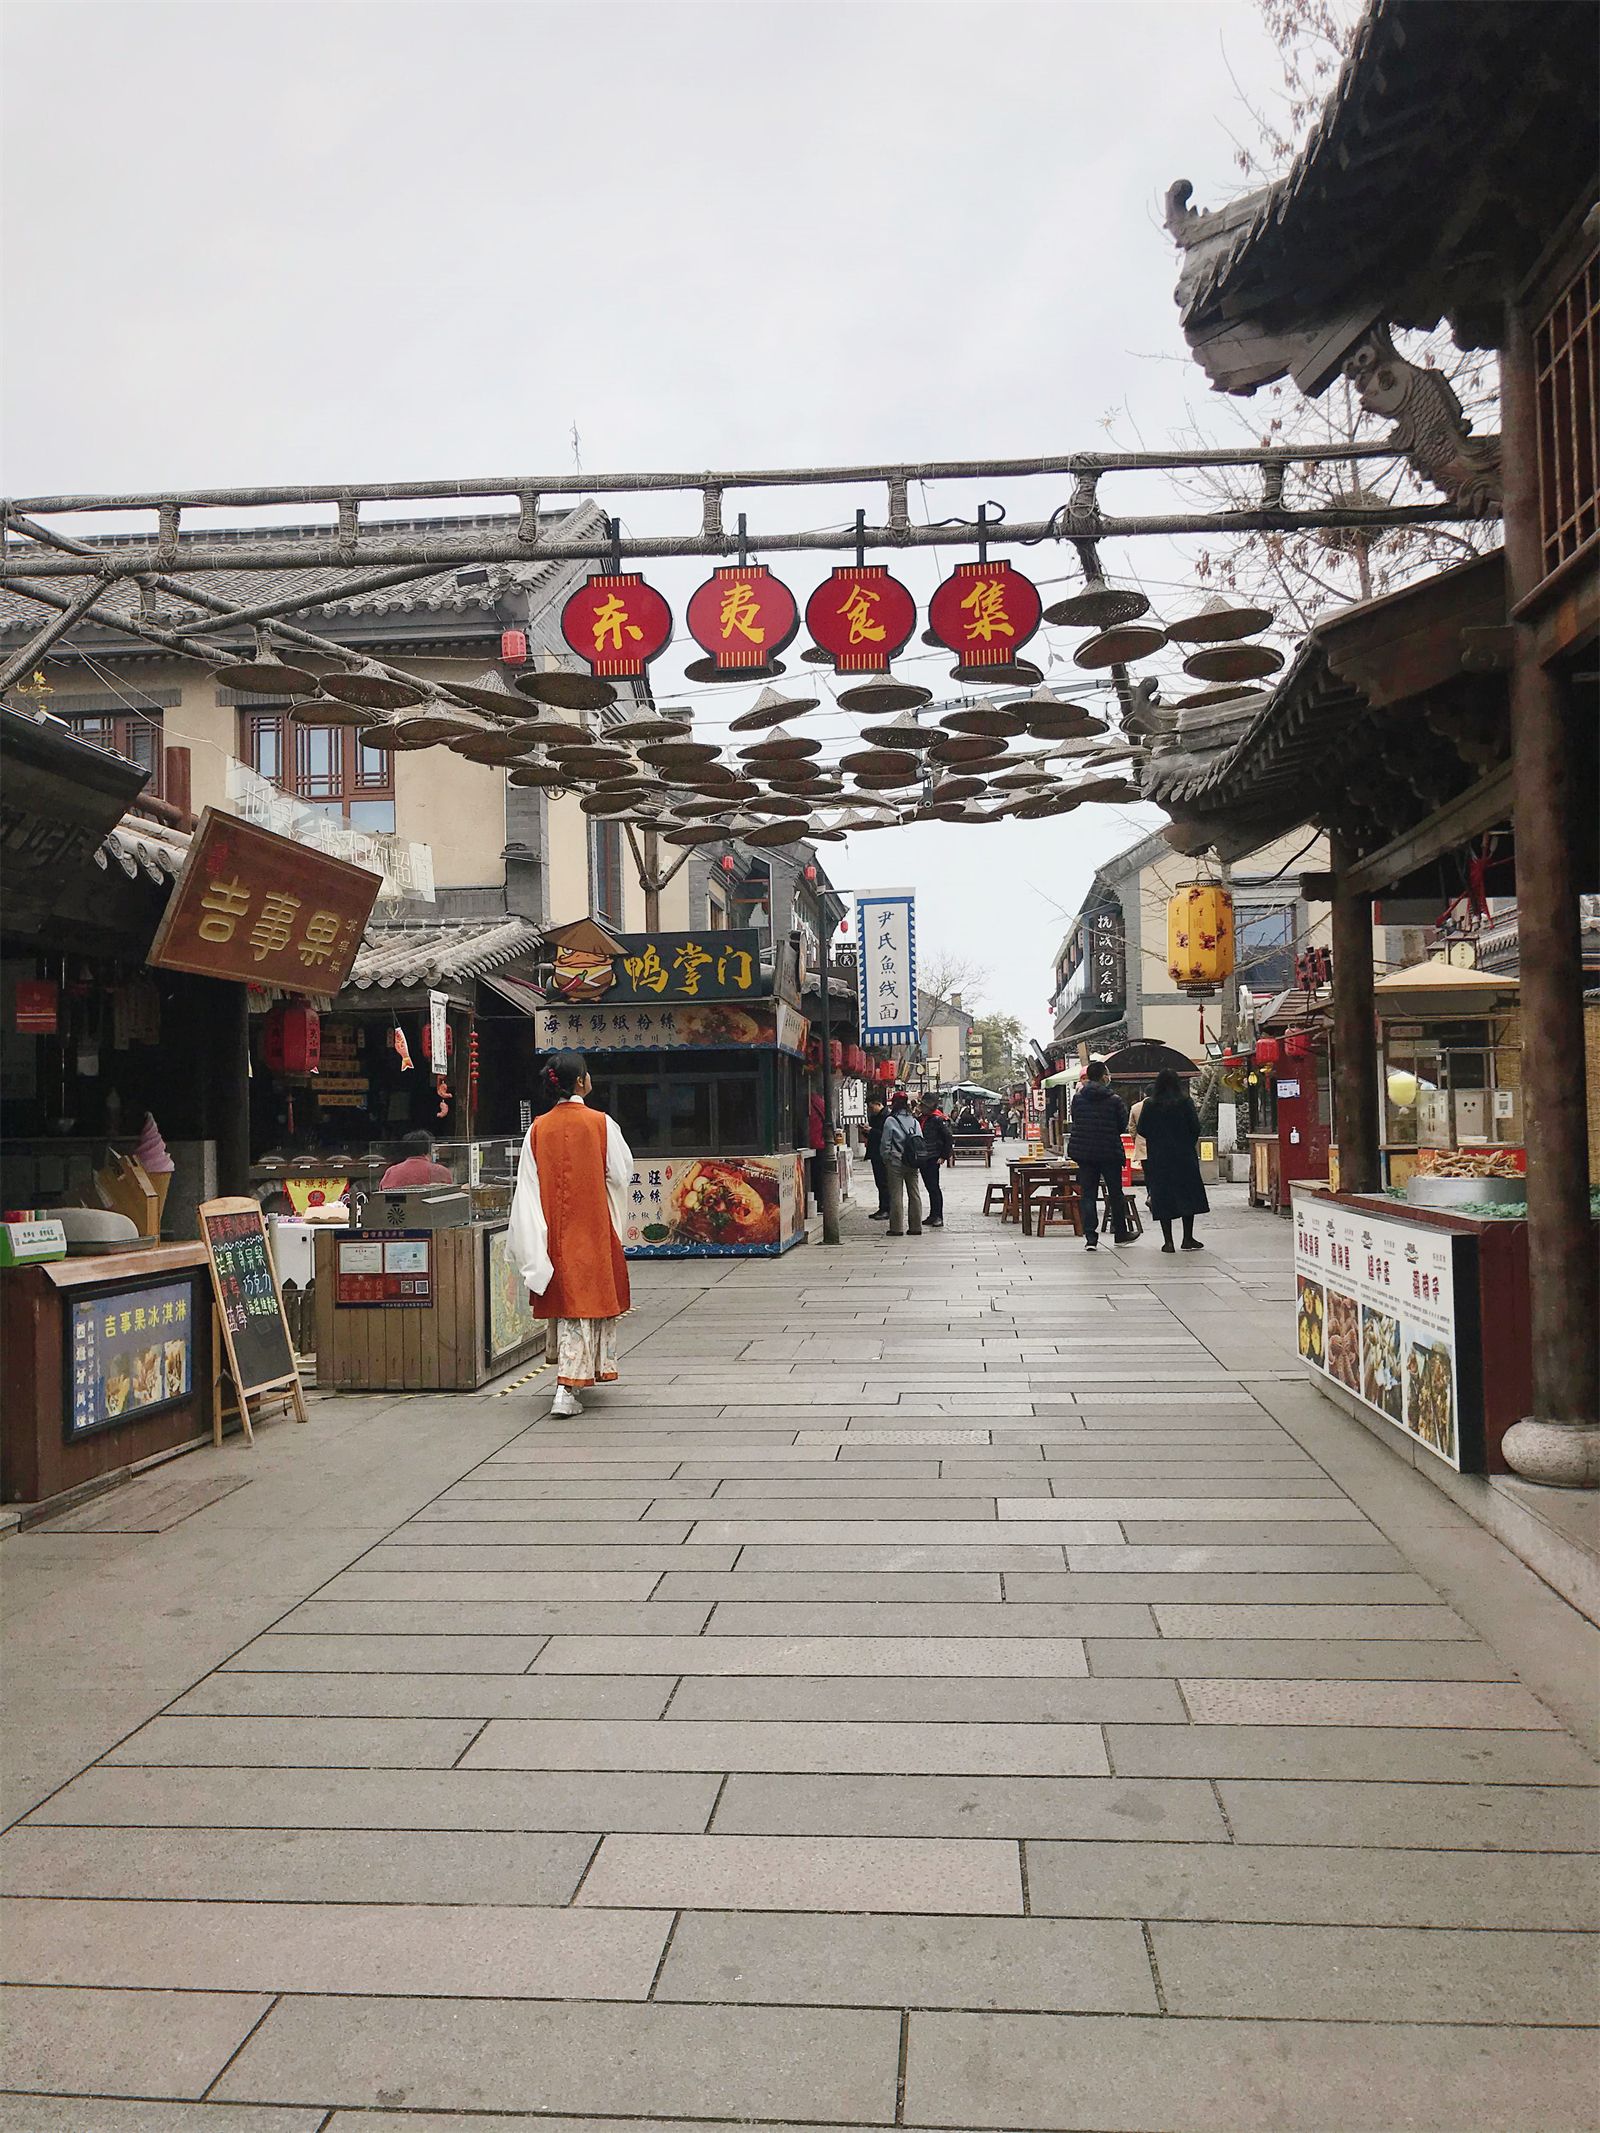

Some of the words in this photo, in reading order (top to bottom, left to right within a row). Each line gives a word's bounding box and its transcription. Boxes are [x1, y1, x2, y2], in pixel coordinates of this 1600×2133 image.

[592, 580, 1014, 651] 东夷食集
[199, 875, 341, 966] 吉事果
[623, 941, 753, 995] 鸭掌门
[1098, 915, 1114, 1004] 抗战纪念馆
[243, 1268, 272, 1295] 巧克力
[105, 1299, 186, 1338] 吉事果冰淇淋
